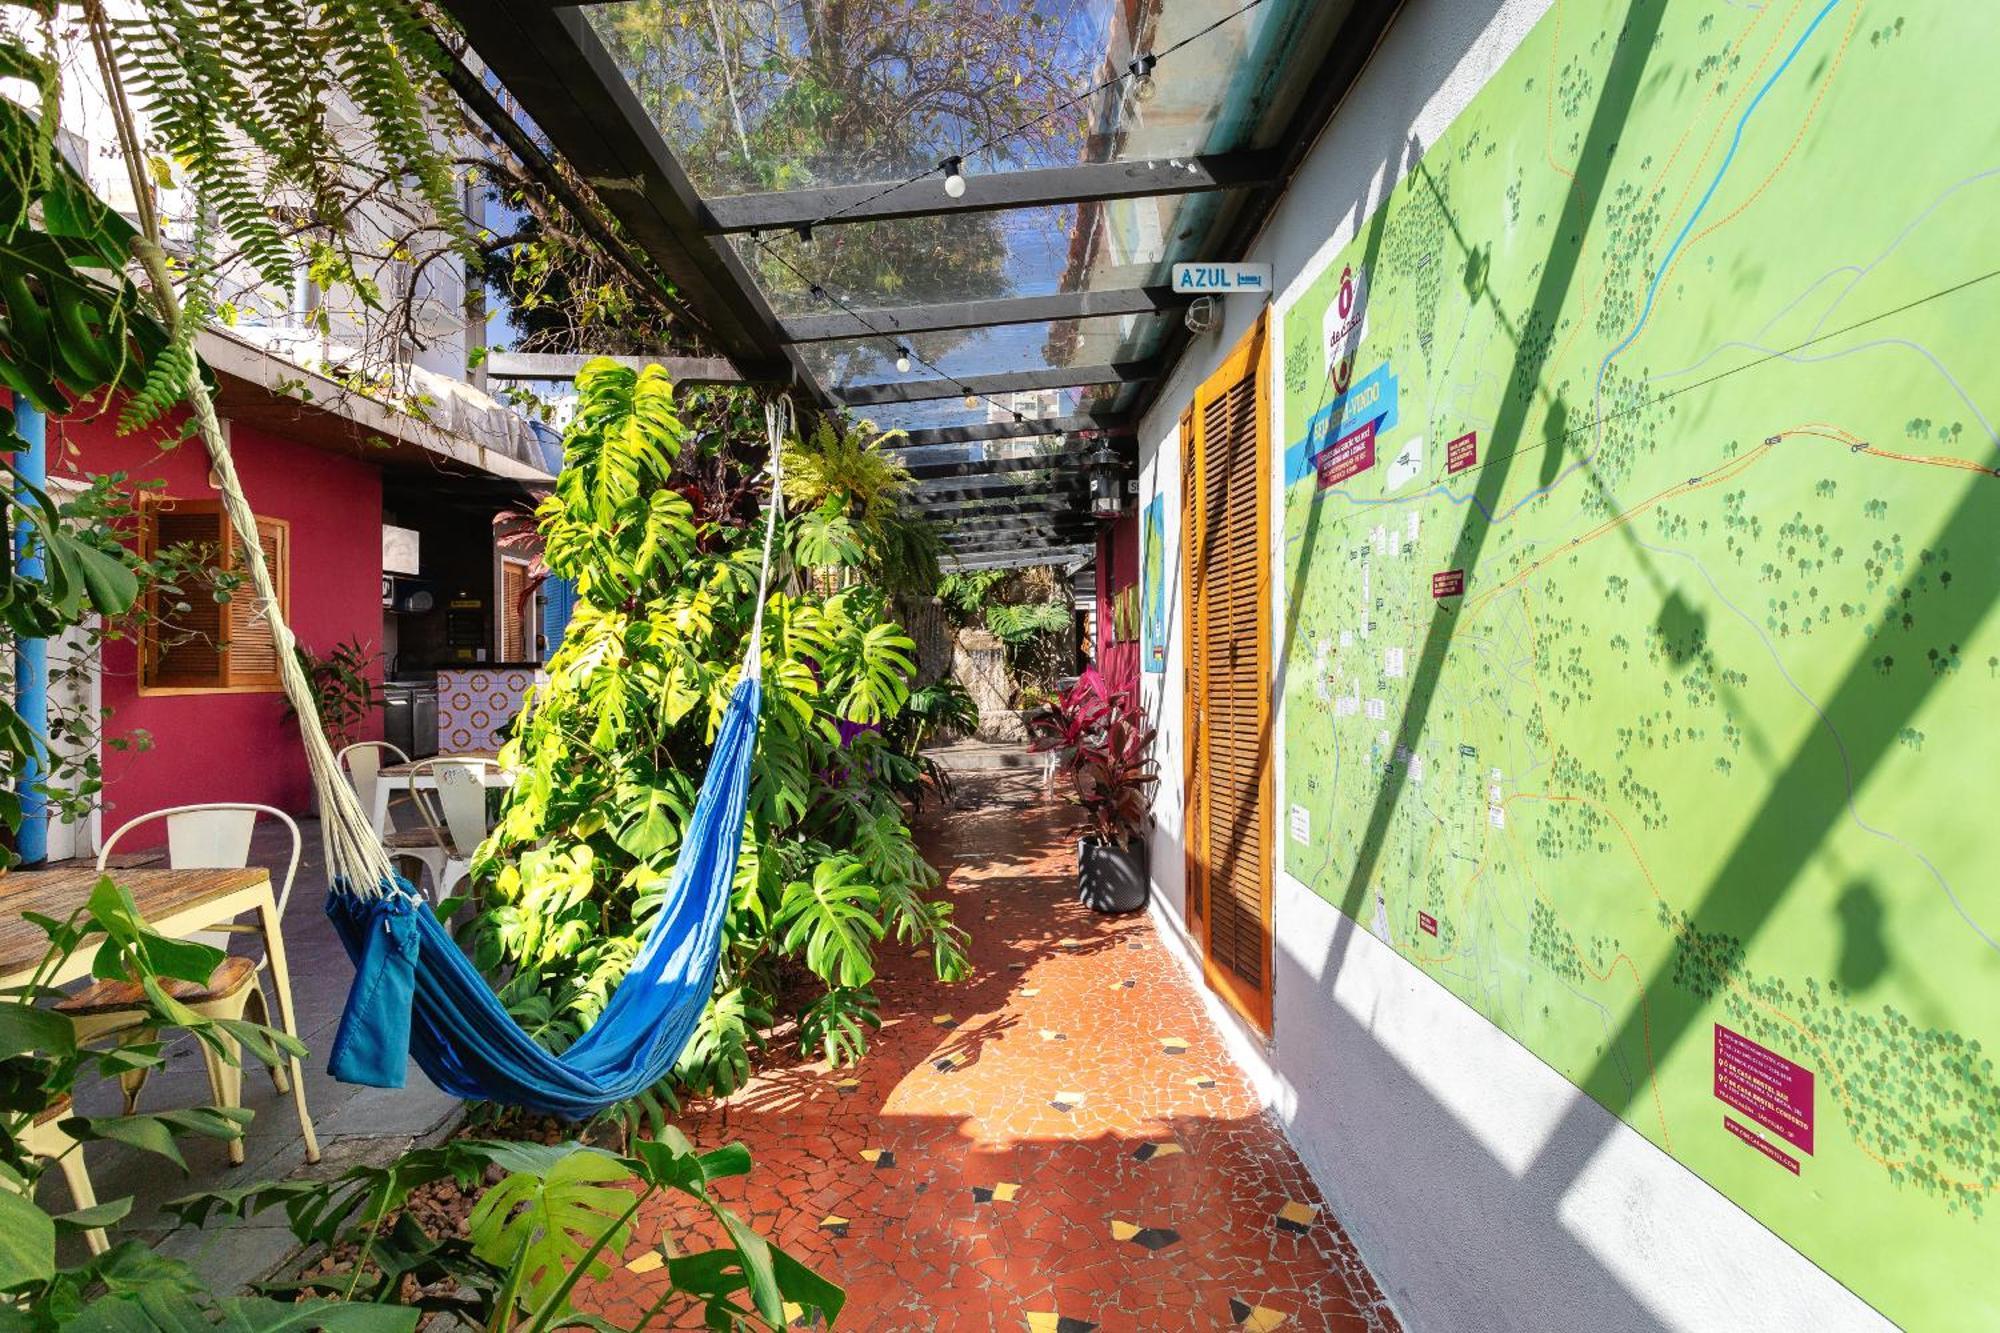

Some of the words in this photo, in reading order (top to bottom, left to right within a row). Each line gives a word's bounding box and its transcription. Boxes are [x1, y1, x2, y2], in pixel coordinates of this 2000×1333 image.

[1181, 268, 1231, 288] AZUL
[1752, 1076, 1774, 1094] HOSTEL
[1752, 1092, 1775, 1112] HOSTEL
